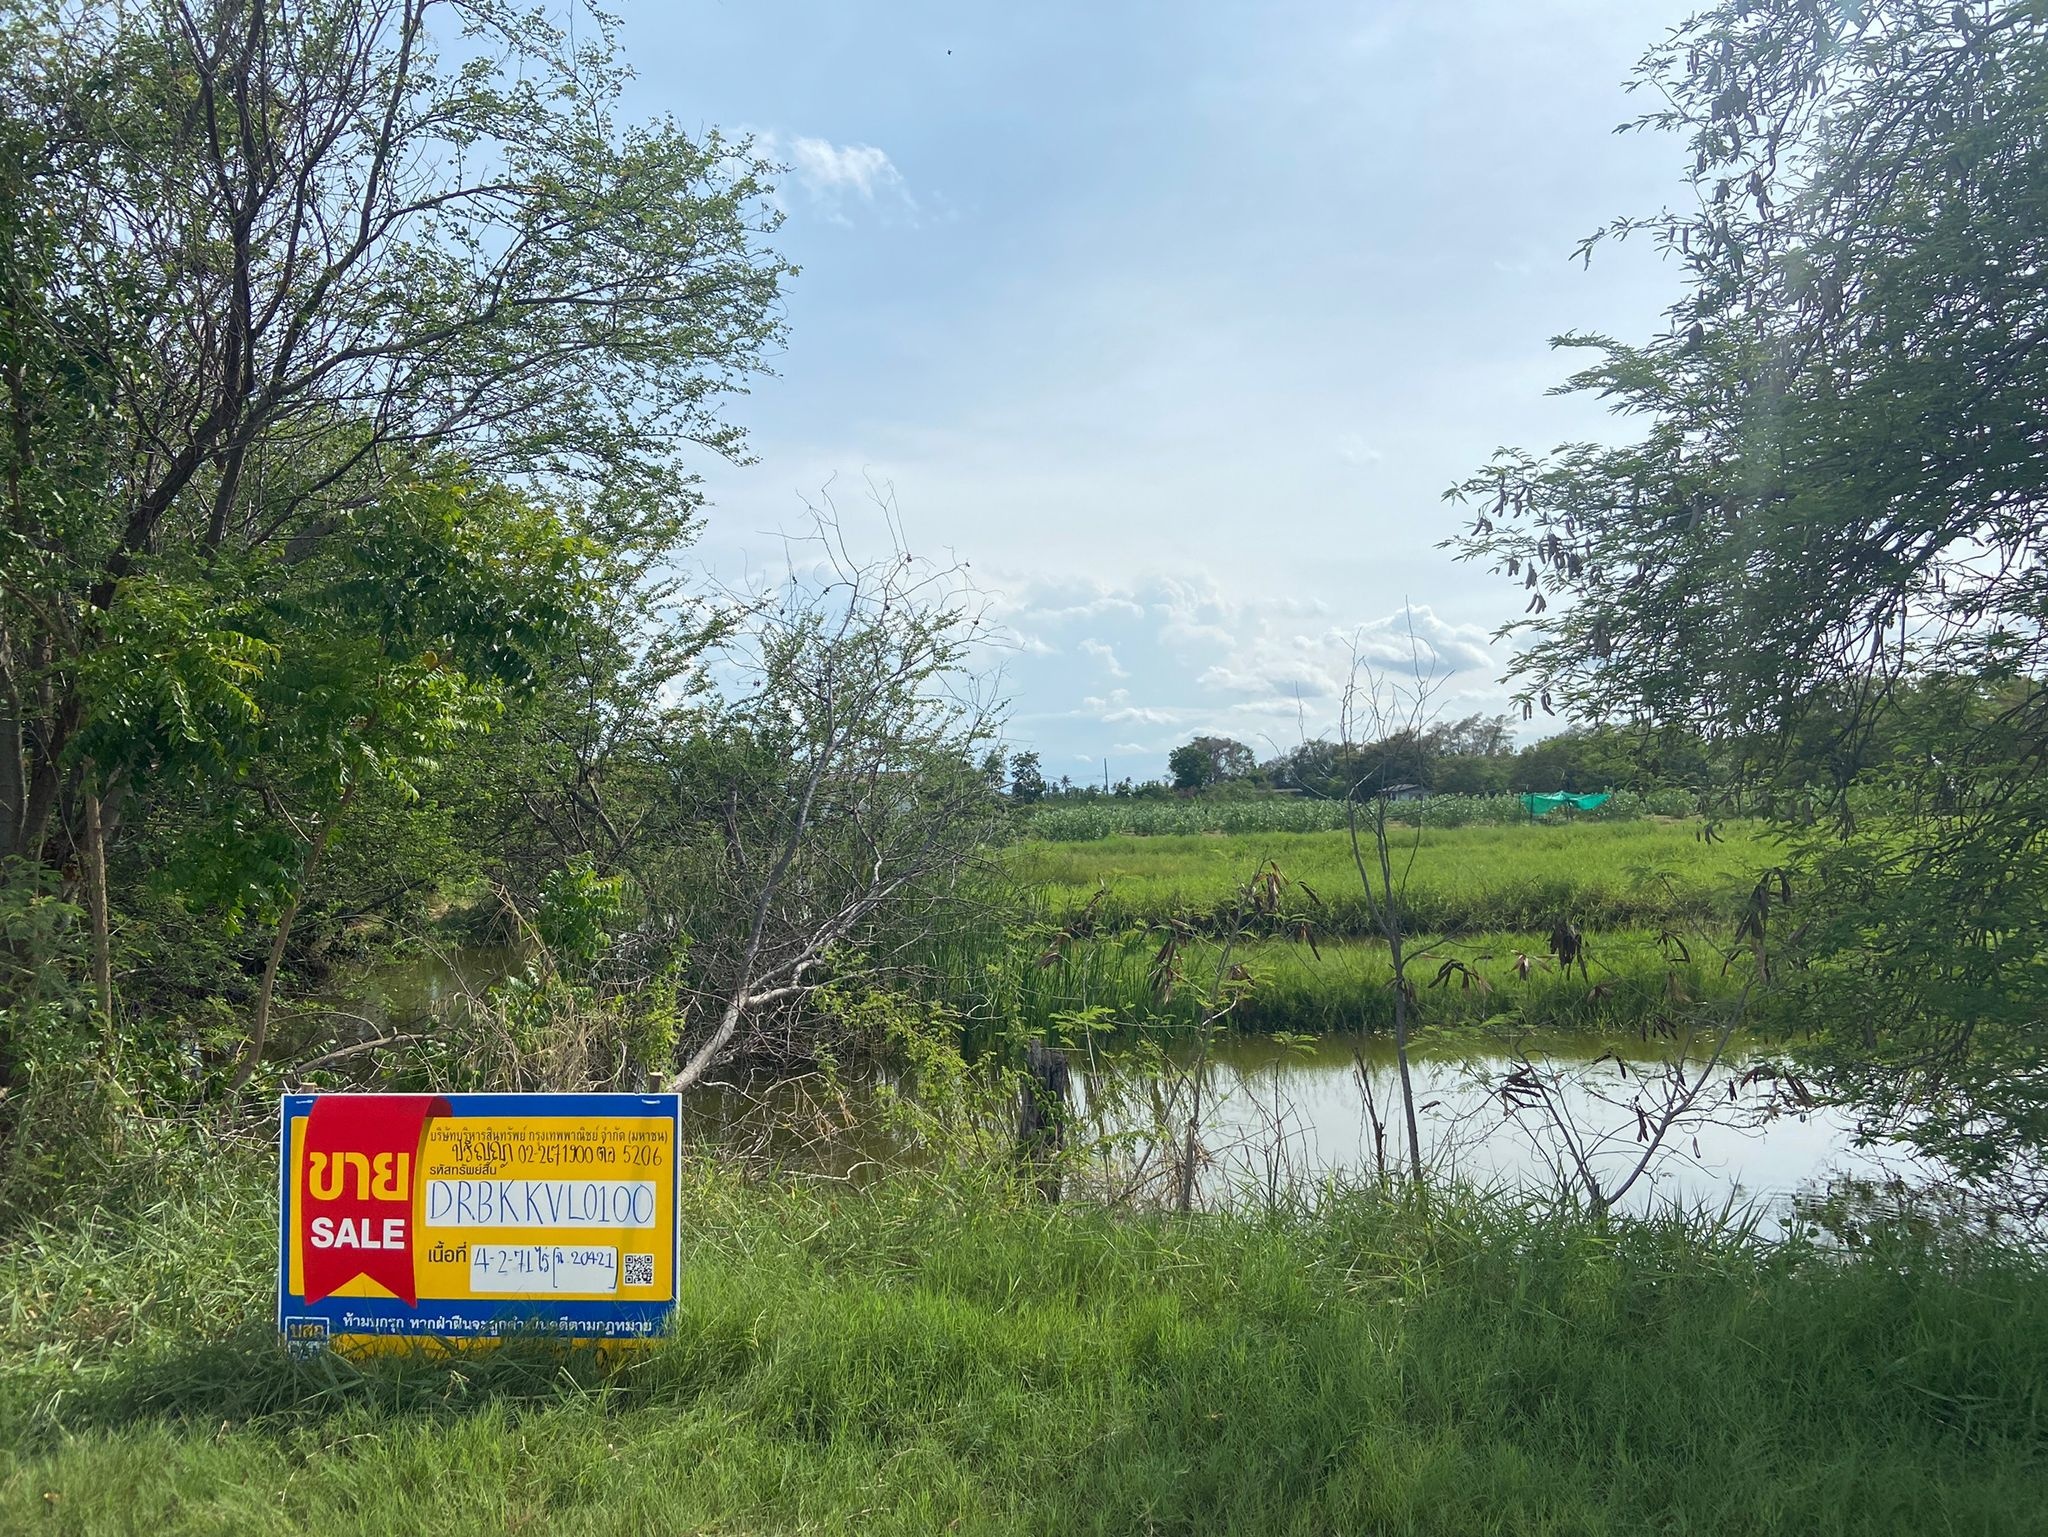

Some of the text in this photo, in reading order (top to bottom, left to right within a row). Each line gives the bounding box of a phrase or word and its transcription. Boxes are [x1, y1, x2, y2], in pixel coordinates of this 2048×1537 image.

[601, 1126, 625, 1141] จำกัด
[628, 1130, 668, 1144] (มหาชน)
[623, 1144, 662, 1167] 5206
[309, 1152, 409, 1201] ขาย
[310, 1217, 405, 1249] SALE
[428, 1241, 467, 1263] เนื้อที่
